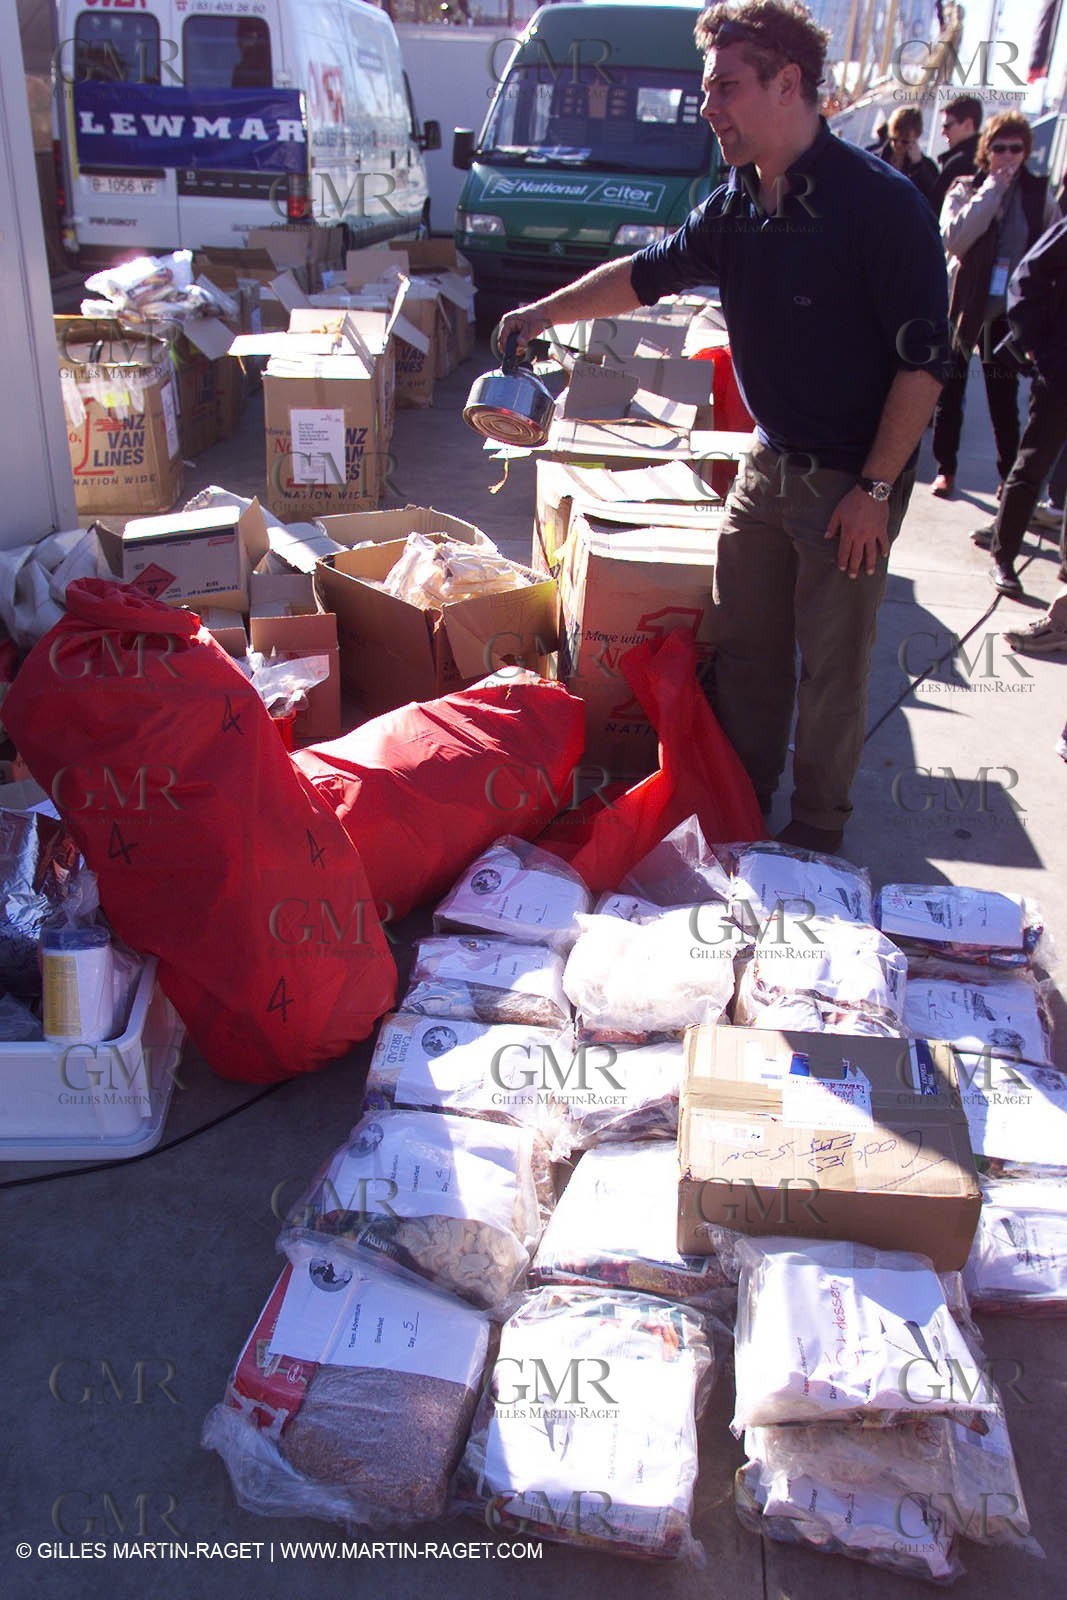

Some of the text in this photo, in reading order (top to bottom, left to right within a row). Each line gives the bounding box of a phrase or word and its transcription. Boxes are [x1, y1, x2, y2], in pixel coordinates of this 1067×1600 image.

[80, 111, 305, 143] LEWMAR
[516, 181, 589, 196] National
[123, 414, 145, 430] NZ
[107, 431, 145, 449] VAN
[93, 448, 145, 467] LINES
[585, 630, 618, 643] Move
[222, 694, 244, 736] 4
[107, 821, 139, 864] 4
[305, 828, 326, 869] 4
[266, 976, 294, 1022] 4
[386, 1033, 403, 1063] BREAD
[352, 1303, 362, 1332] Adventure
[374, 1316, 385, 1344] Breakfast
[407, 1336, 416, 1348] Day
